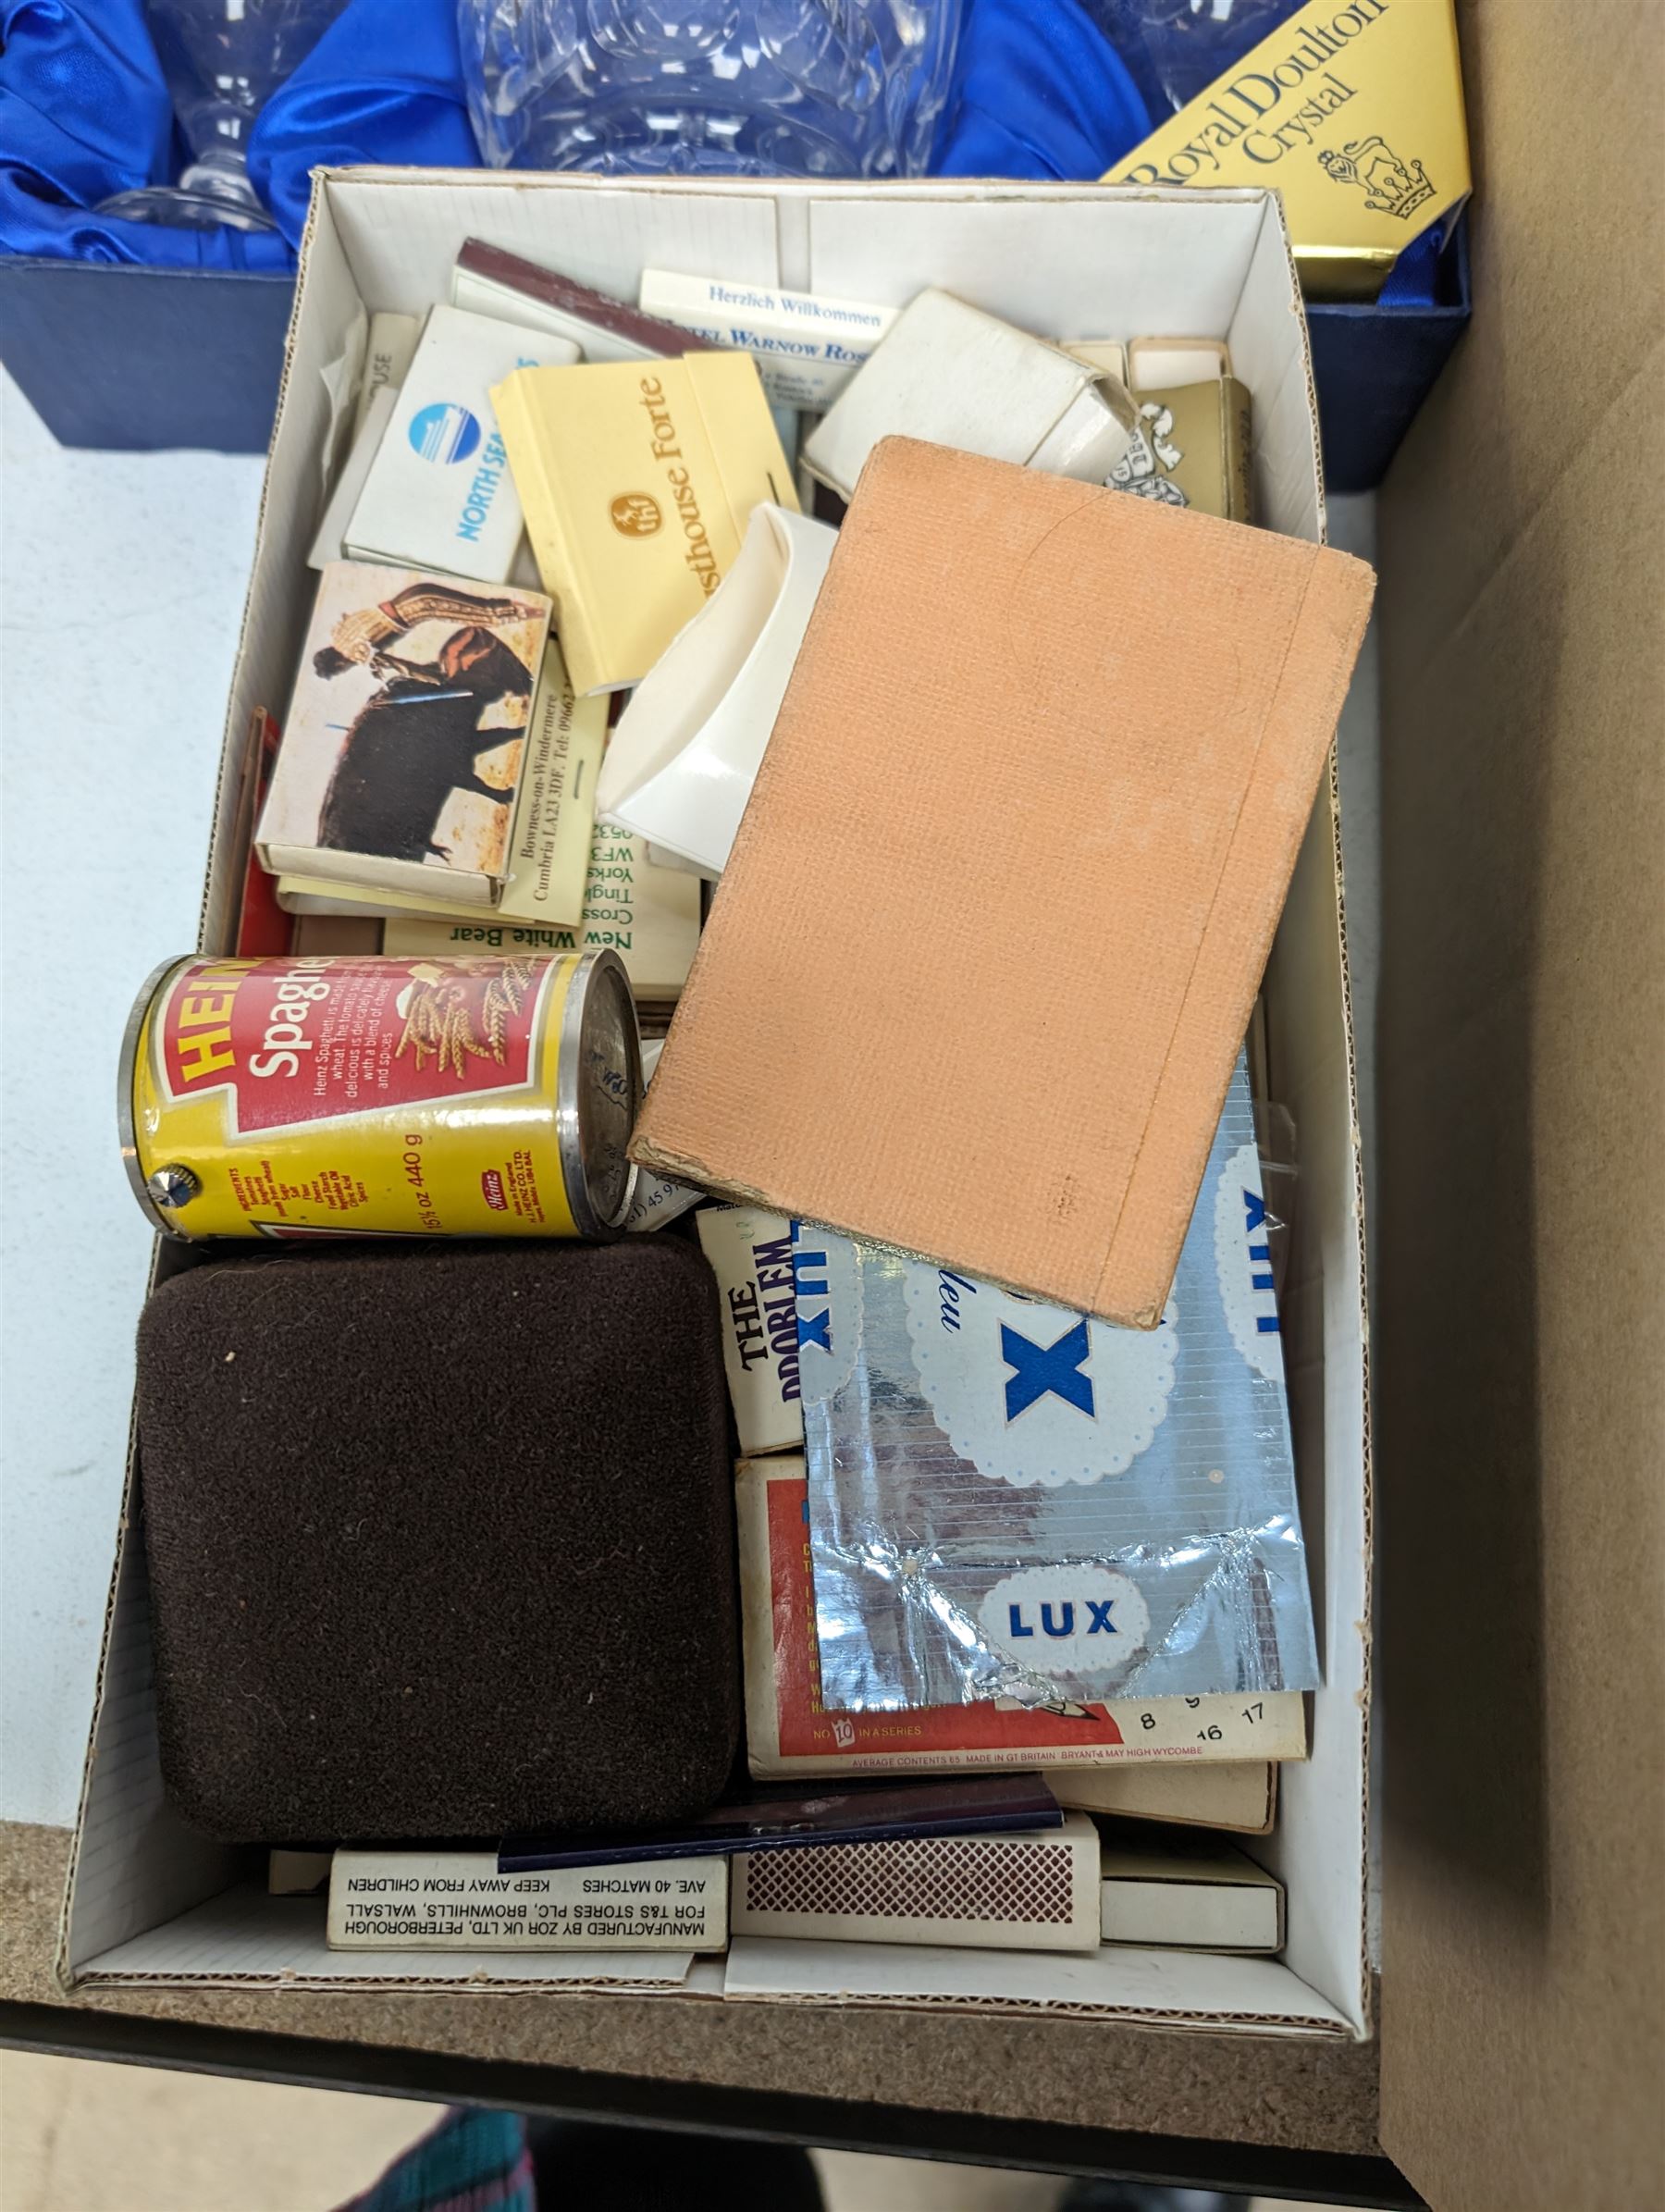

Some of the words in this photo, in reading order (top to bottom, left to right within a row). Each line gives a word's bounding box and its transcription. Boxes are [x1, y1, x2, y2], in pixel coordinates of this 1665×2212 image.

[1125, 103, 1247, 184] Royal
[1224, 0, 1391, 119] Doulton
[1242, 73, 1358, 165] Crystal
[709, 286, 774, 310] Herzlich
[780, 298, 882, 327] Willkommen
[730, 328, 820, 357] WARNOW
[639, 377, 683, 462] Forte
[455, 466, 501, 542] NORTH
[552, 735, 570, 760] Tel:
[520, 694, 558, 859] Bowness-on-Windermere
[542, 800, 560, 837] LA23
[533, 841, 555, 903] Cumbria
[582, 909, 634, 925] Cross
[450, 928, 503, 946] Bear
[513, 928, 576, 948] White
[585, 932, 633, 950] New
[328, 985, 344, 1006] made
[327, 1007, 337, 1015] is
[339, 993, 357, 1022] tomato
[352, 994, 375, 1035] delicately
[370, 1007, 382, 1018] of
[177, 958, 262, 1082] HEIN
[248, 958, 336, 1079] Spaghe
[315, 1017, 336, 1063] Spaghetti
[333, 1024, 349, 1043] The
[351, 1038, 362, 1046] is
[364, 1019, 381, 1046] blend
[378, 1032, 393, 1067] spices
[344, 1049, 360, 1098] delicious
[362, 1058, 375, 1081] with
[376, 1069, 388, 1090] and
[314, 1066, 327, 1096] Heinz
[405, 1134, 423, 1146] g
[403, 1152, 425, 1188] 440
[504, 1162, 517, 1193] England
[228, 1168, 252, 1212] INGREDIENTS
[311, 1180, 325, 1203] Cheese
[318, 1171, 332, 1193] Starch
[341, 1175, 353, 1191] Acid
[355, 1181, 368, 1203] Spices
[485, 1173, 504, 1210] Heinz
[416, 1192, 433, 1208] oz
[519, 1188, 532, 1212] HEINZ
[728, 1280, 769, 1372] THE
[1009, 1600, 1117, 1637] LUX
[1141, 1712, 1156, 1730] 8
[1241, 1702, 1264, 1724] 17
[813, 1729, 830, 1739] NO
[836, 1723, 853, 1743] 10
[859, 1728, 870, 1736] IN
[880, 1725, 922, 1736] SERIES
[1197, 1724, 1223, 1741] 16
[852, 1758, 895, 1768] AVERAGE
[897, 1756, 948, 1766] CONTENTS
[966, 1754, 993, 1763] MADE
[994, 1753, 1004, 1762] IN
[1020, 1751, 1055, 1761] BRITAIN
[1061, 1749, 1096, 1760] BRYANT
[1105, 1749, 1125, 1758] MAY
[1126, 1748, 1152, 1757] HIGH
[1153, 1746, 1203, 1756] WYCOMBE
[348, 1878, 420, 1891] CHILDREN
[424, 1879, 464, 1892] FROM
[469, 1879, 511, 1892] AWAY
[513, 1879, 550, 1893] KEEP
[583, 1879, 650, 1893] MATCHES
[654, 1879, 672, 1893] 40
[678, 1879, 706, 1893] AVE.
[346, 1902, 416, 1917] WALSALL
[424, 1903, 528, 1919] BROWNHILLS,
[534, 1904, 568, 1920] PLC,
[574, 1904, 635, 1918] STORES
[640, 1905, 669, 1918] T&S
[677, 1905, 705, 1918] FOR
[345, 1920, 463, 1934] PETERBOROUGH
[468, 1922, 499, 1935] LTD,
[506, 1922, 524, 1934] UK
[529, 1922, 561, 1934] ZOR
[564, 1922, 582, 1934] BY
[586, 1922, 705, 1935] MANUFACTURED
